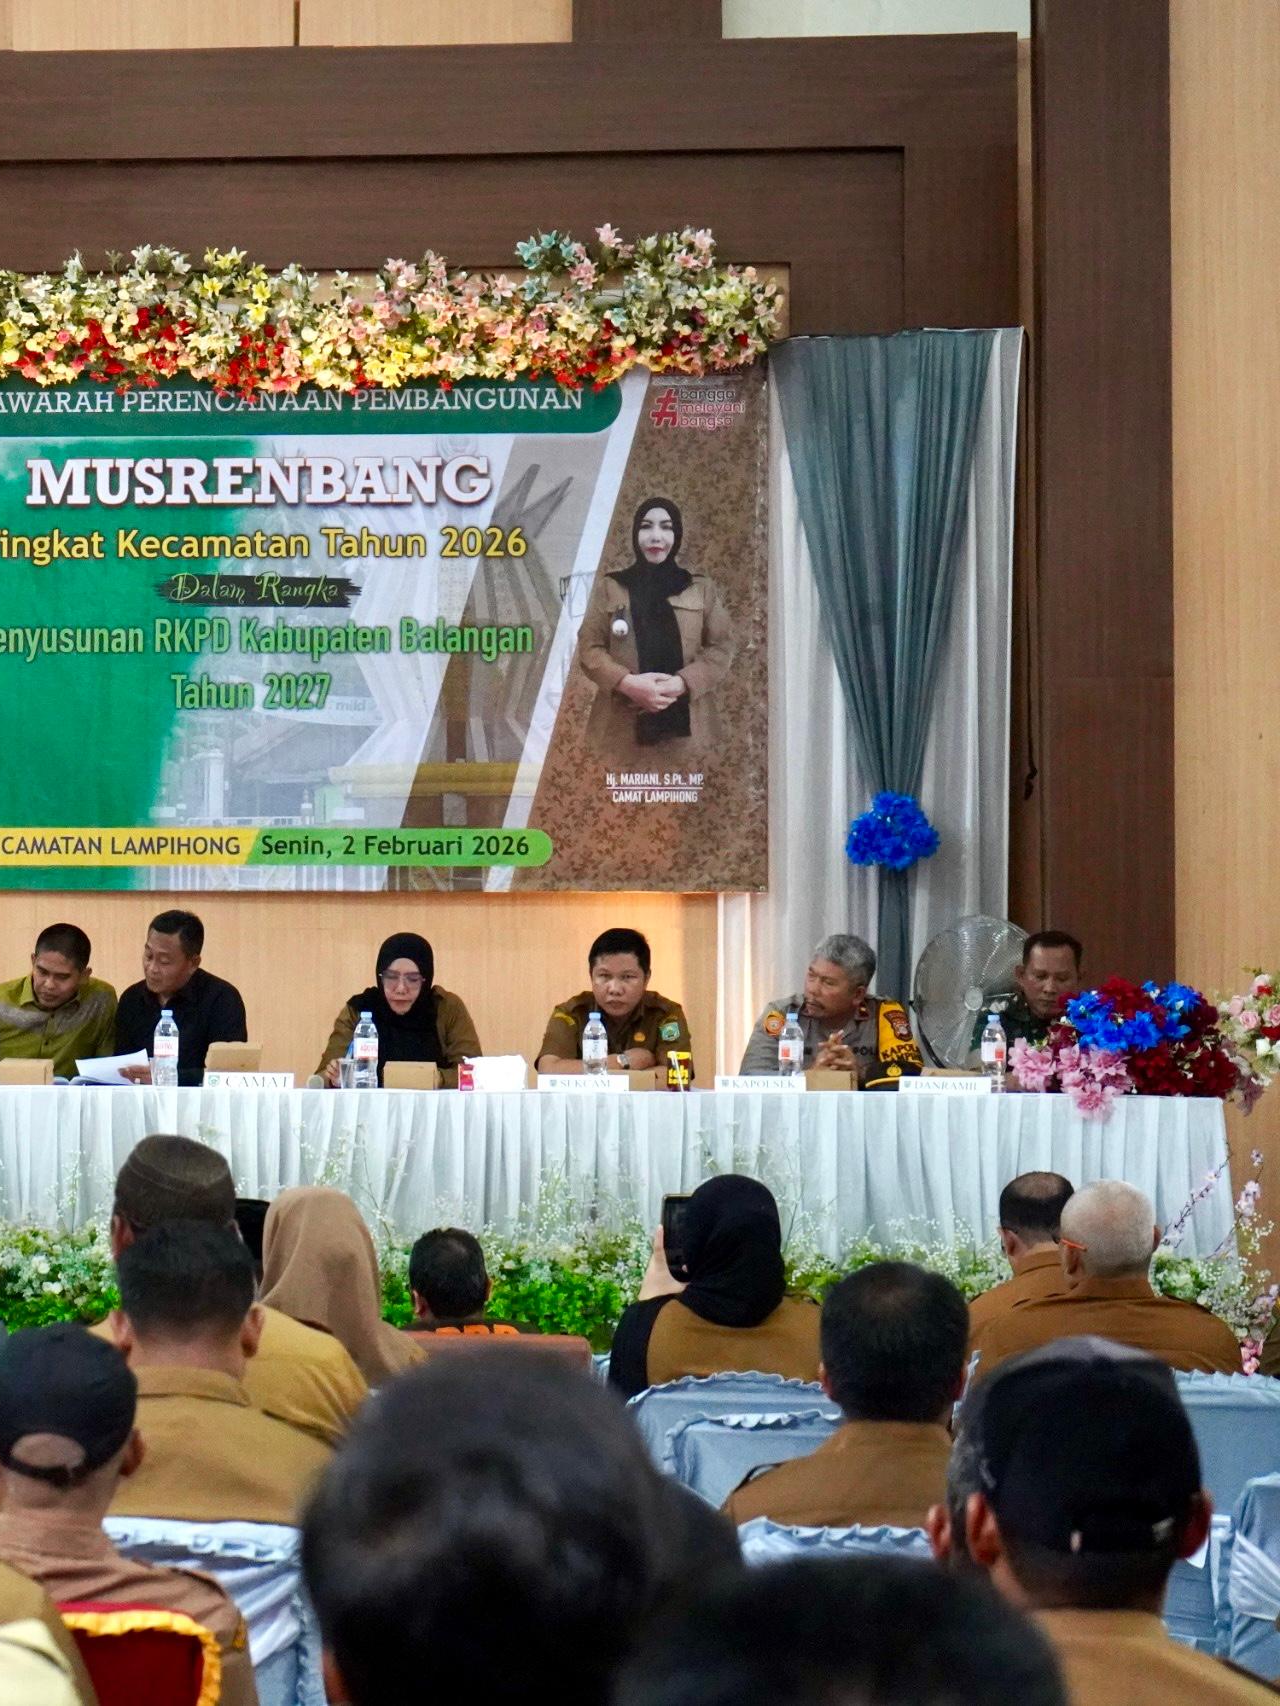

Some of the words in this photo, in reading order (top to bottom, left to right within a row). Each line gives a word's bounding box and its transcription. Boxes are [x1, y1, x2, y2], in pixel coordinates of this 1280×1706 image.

[352, 387, 584, 411] PEMBANGUNAN
[680, 388, 736, 402] bangga
[680, 400, 746, 415] melayani
[680, 416, 733, 431] bangsa
[25, 455, 492, 505] MUSRENBANG
[117, 527, 310, 559] Kecamatan
[320, 526, 427, 558] Tahun
[440, 526, 528, 558] 2026
[169, 571, 246, 605] Dalam
[253, 571, 339, 609] Rangka
[154, 617, 230, 653] RKPD
[239, 616, 392, 663] Kabupaten
[399, 616, 534, 663] Balangan
[171, 673, 254, 710] Tahun
[262, 672, 332, 710] 2027
[612, 791, 643, 803] CAMAT
[644, 791, 699, 803] LAMPIHONG
[111, 835, 241, 855] LAMPIHONG
[261, 835, 333, 859] Senin,
[343, 835, 356, 855] 2
[364, 835, 463, 856] Februari
[472, 835, 530, 856] 2026
[225, 1075, 288, 1088] CAMAT
[732, 1079, 796, 1089] KAPOLSEK
[914, 1080, 977, 1091] DANRAMIL
